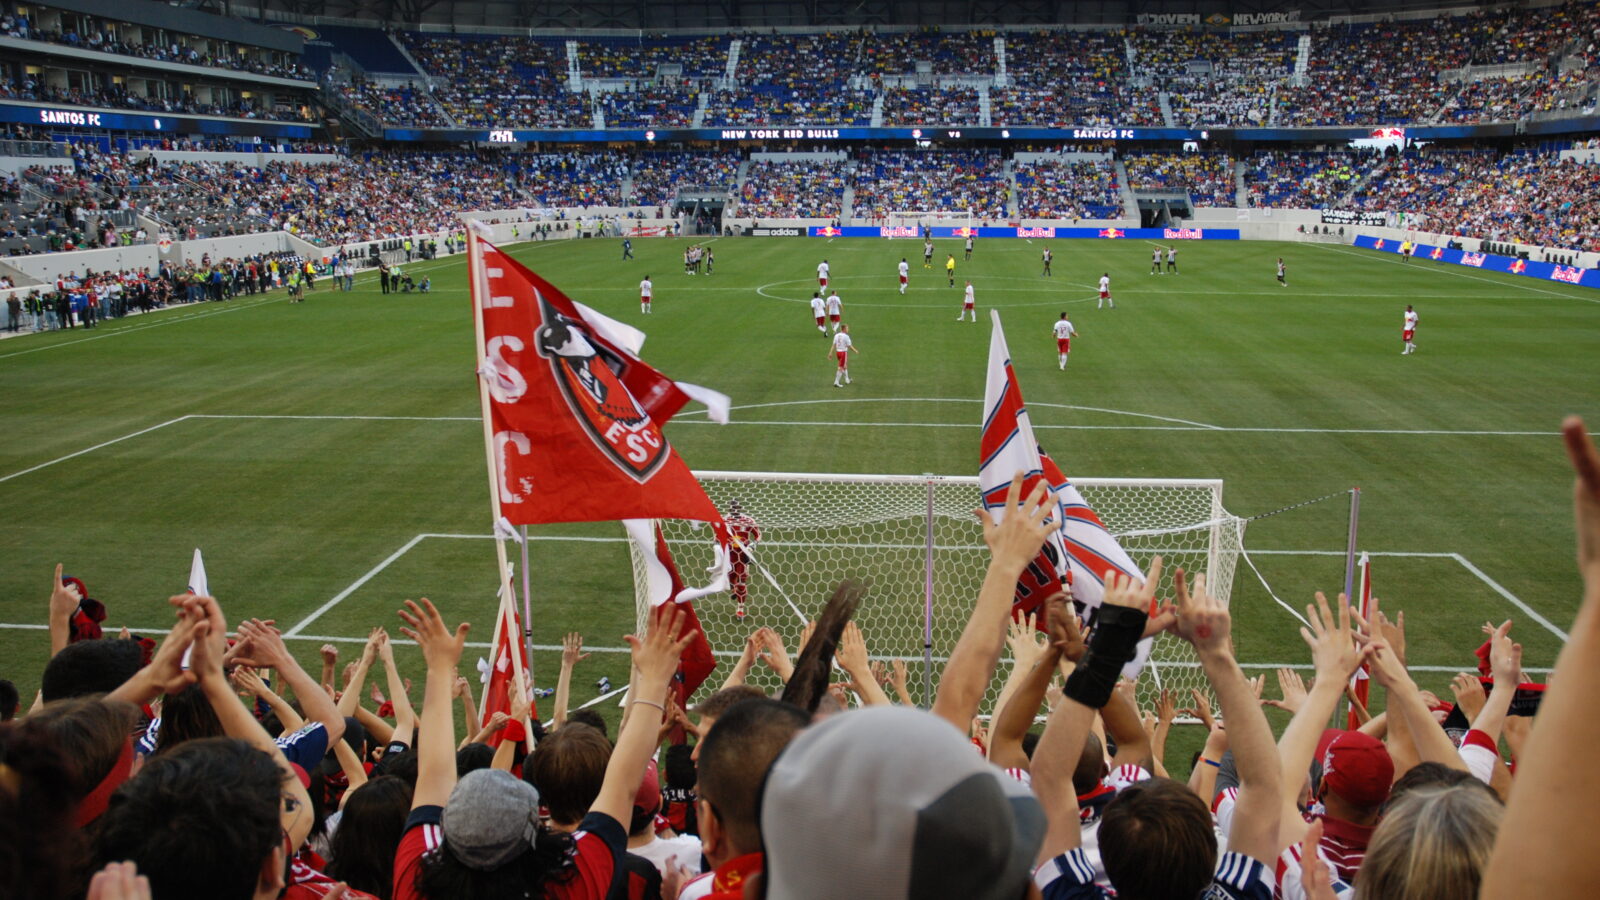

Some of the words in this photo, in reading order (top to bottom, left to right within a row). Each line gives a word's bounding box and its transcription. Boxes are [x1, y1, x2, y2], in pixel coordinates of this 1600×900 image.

[40, 110, 85, 126] SANTOS
[88, 113, 101, 126] FC
[722, 130, 746, 139] NEW
[750, 130, 779, 138] YORK
[784, 130, 803, 138] RED
[808, 130, 839, 138] BULLS
[1073, 130, 1117, 139] SANTOS
[1121, 130, 1134, 139] FC
[770, 228, 799, 236] adidas
[1018, 227, 1036, 237] Red
[1036, 227, 1055, 237] Bull
[1164, 228, 1182, 238] Red
[1182, 228, 1202, 238] Bull
[605, 423, 661, 463] ESC
